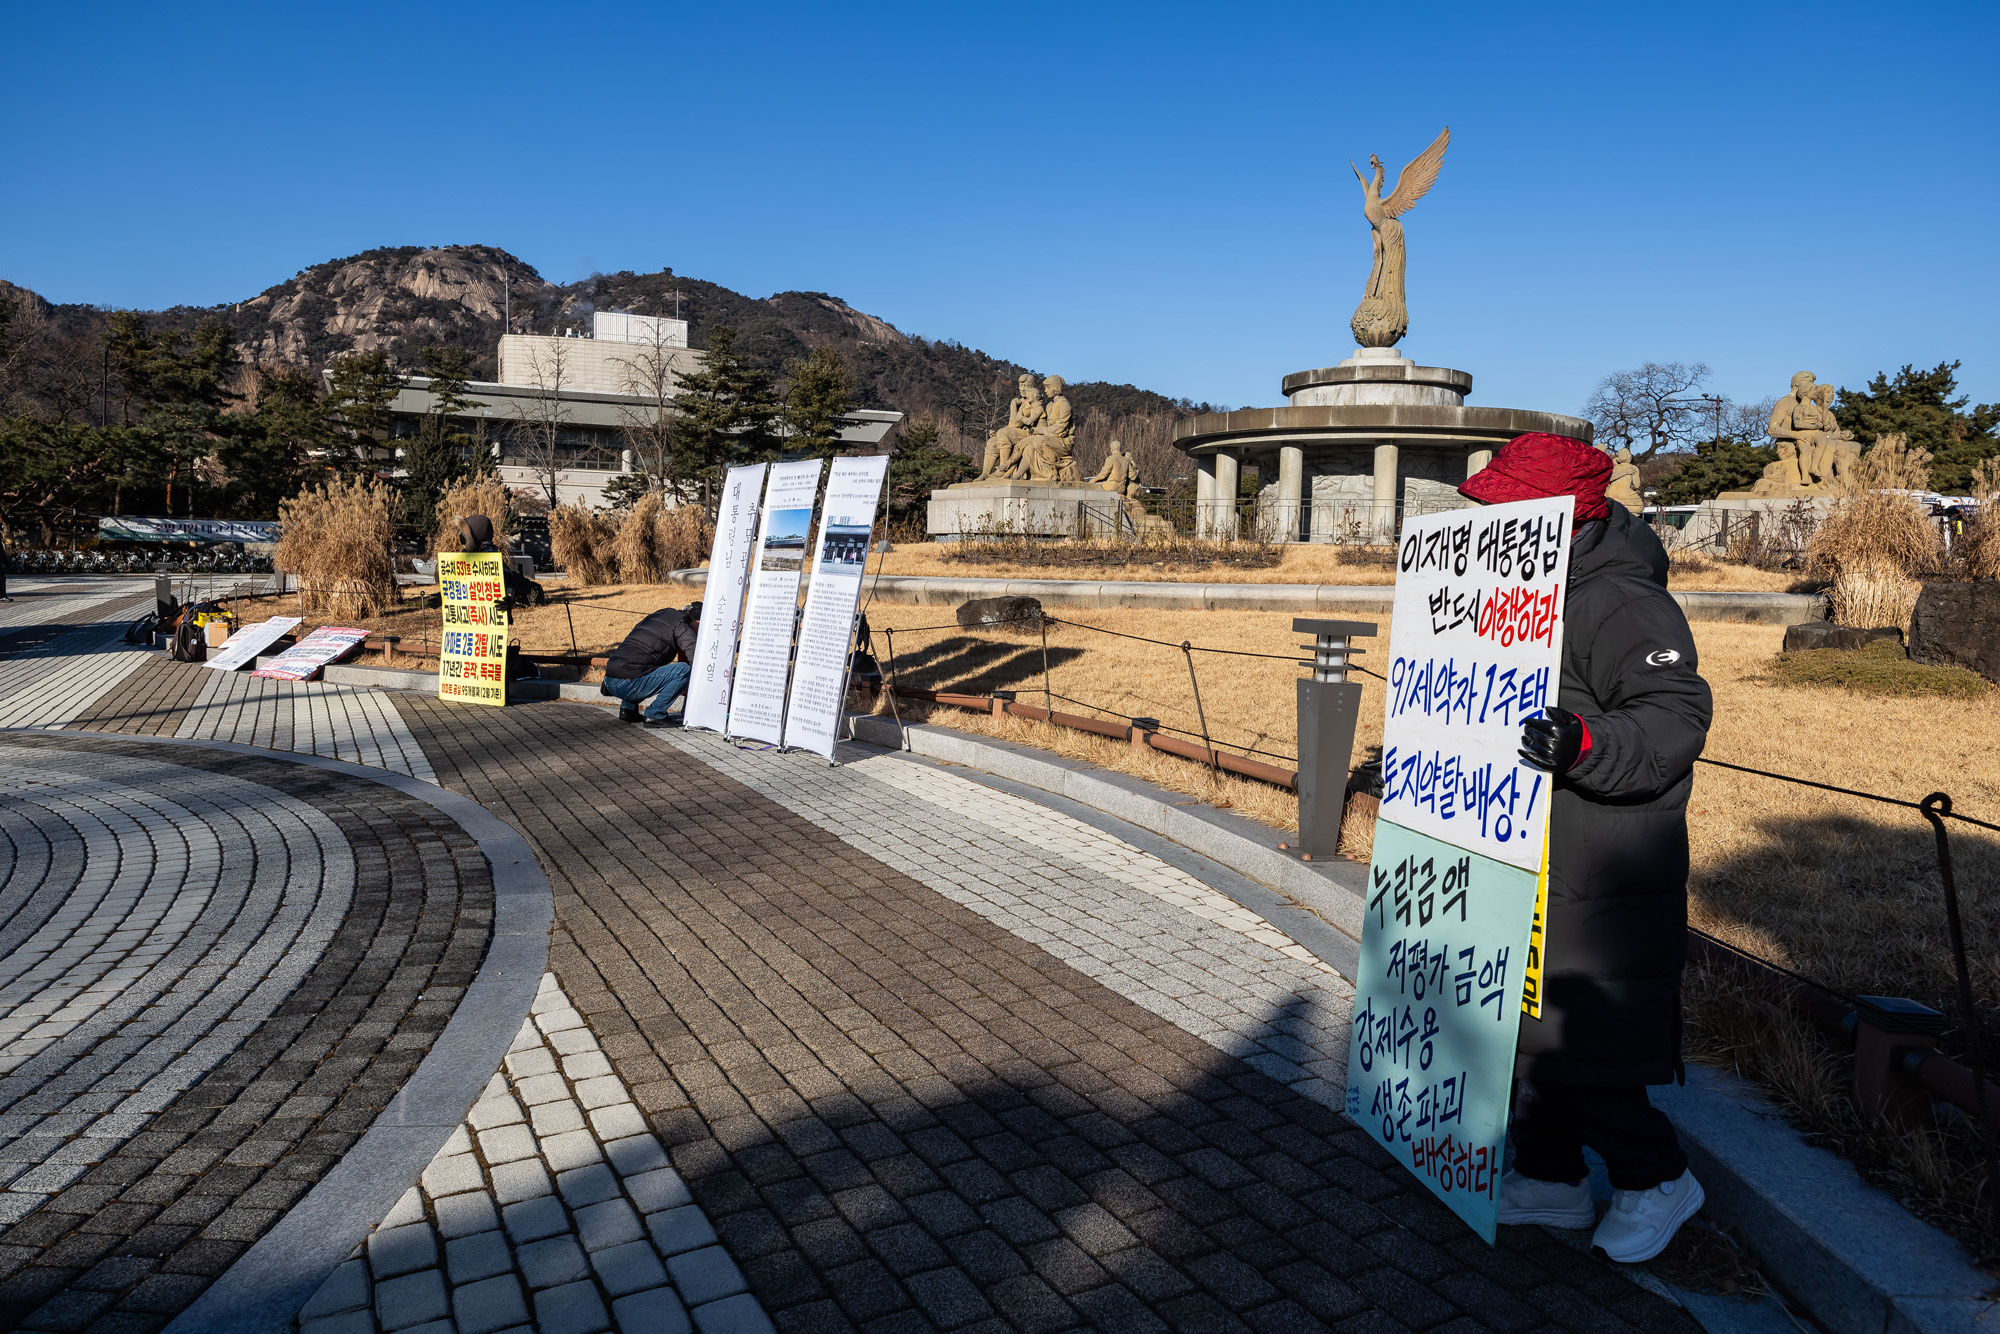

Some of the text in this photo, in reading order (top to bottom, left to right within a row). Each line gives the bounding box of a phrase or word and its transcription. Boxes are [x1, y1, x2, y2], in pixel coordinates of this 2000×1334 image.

[1401, 512, 1564, 581] 이재명 대통령님
[442, 580, 502, 602] 국정원의 살인청부
[707, 482, 741, 682] 대통령님 순국선열
[443, 660, 502, 682] 17년간 공작, 독극물
[444, 631, 503, 658] 아파트 2동 강탈 시도
[1387, 938, 1449, 1001] 저평가
[1454, 945, 1510, 1022] 금액
[1411, 1133, 1498, 1201] 배상하라
